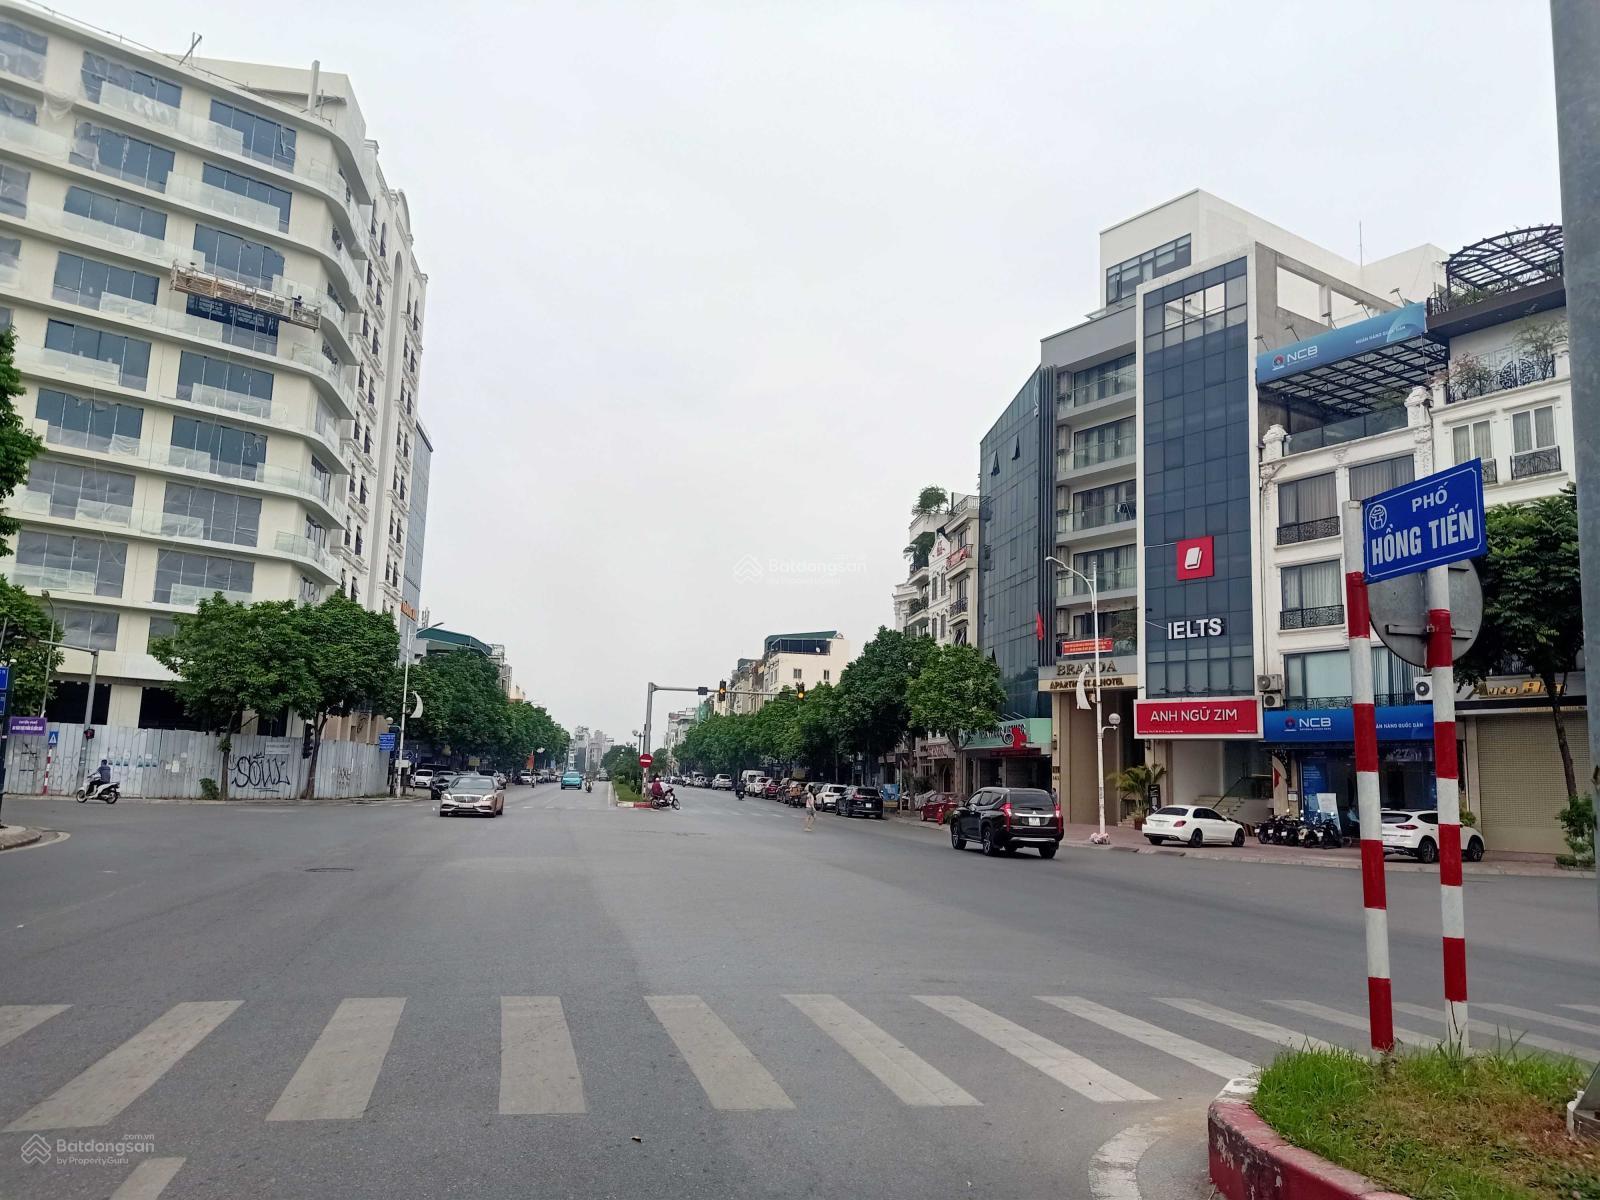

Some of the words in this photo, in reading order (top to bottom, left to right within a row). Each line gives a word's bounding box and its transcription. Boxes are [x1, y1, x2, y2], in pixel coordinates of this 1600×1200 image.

[1287, 345, 1318, 363] NCB
[1411, 481, 1448, 513] PHỐ
[1371, 523, 1422, 566] HỒNG
[1428, 503, 1475, 549] TIẾN
[1167, 617, 1223, 640] IELTS
[1150, 710, 1178, 722] ANH
[1181, 706, 1211, 722] NGỮ
[1213, 708, 1238, 721] ZIM
[1299, 717, 1332, 728] NCB
